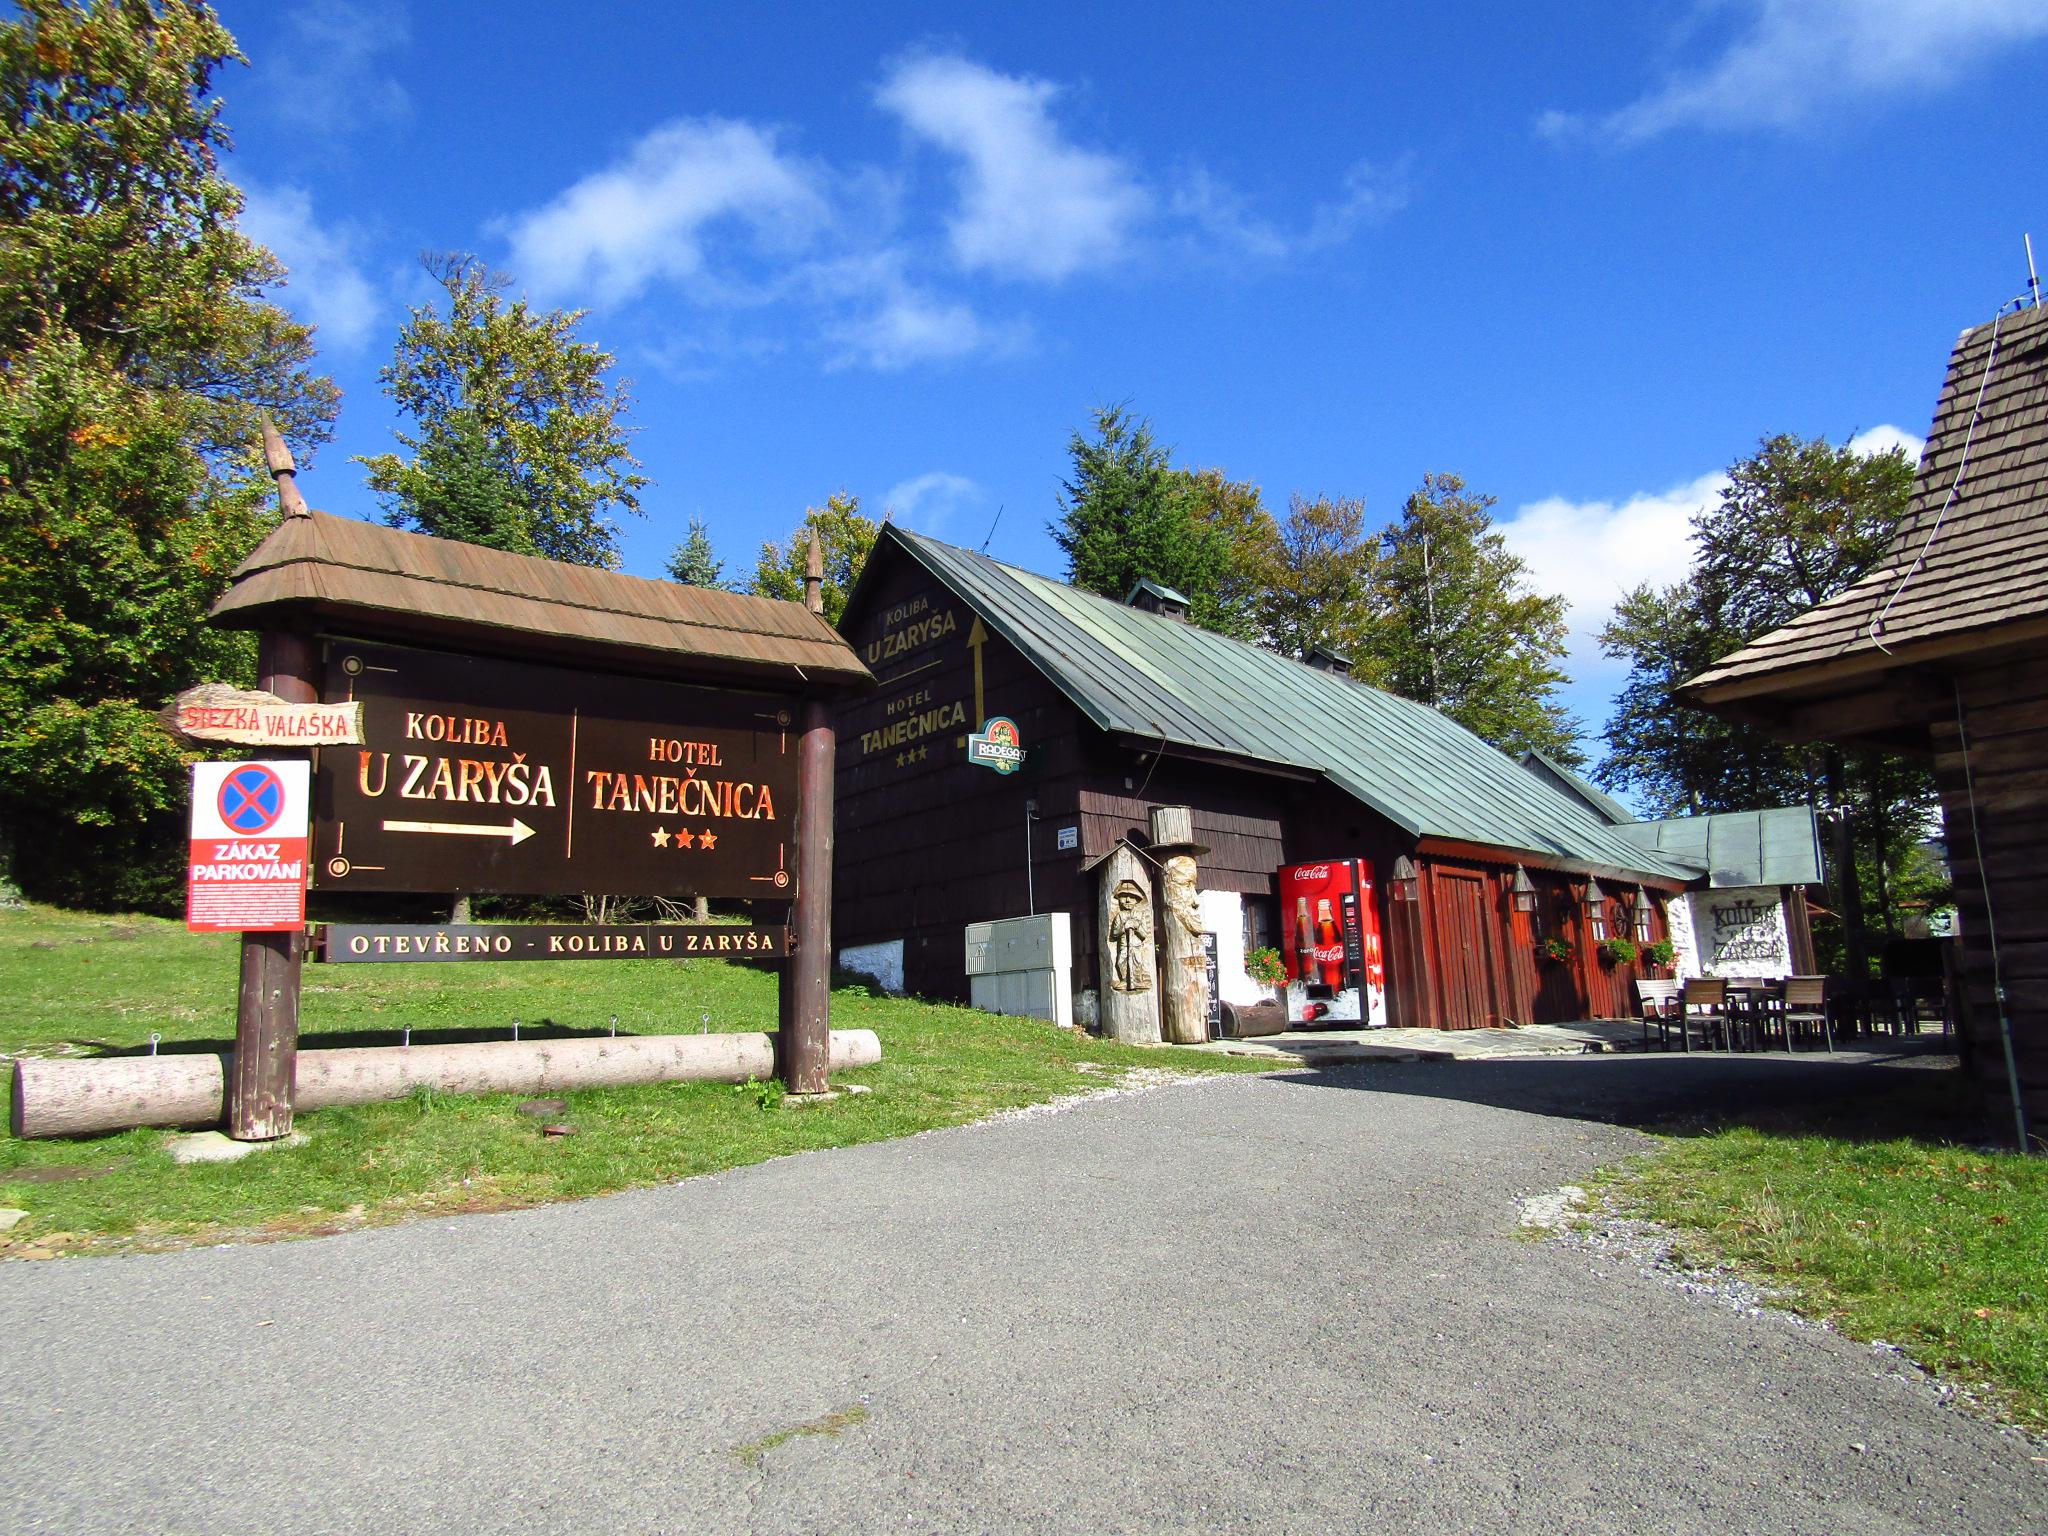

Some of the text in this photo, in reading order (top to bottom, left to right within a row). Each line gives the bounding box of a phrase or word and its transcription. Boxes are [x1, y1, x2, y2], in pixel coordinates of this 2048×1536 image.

[886, 597, 929, 626] KOLIBA
[868, 608, 957, 665] U ZARYŠA
[887, 690, 931, 715] HOTEL
[184, 707, 347, 737] STEZKA VALAŠKA
[407, 711, 509, 747] KOLIBA
[861, 701, 966, 755] TANEČNICA
[650, 737, 723, 767] HOTEL
[978, 743, 1028, 763] RADEGAST
[359, 750, 557, 807] U ZARYŠA
[587, 767, 776, 821] TANEČNICA
[214, 840, 281, 861] ZÁKAZ
[193, 859, 302, 881] PARKOVÁNÍ
[350, 931, 513, 954] OTEVŘENO
[550, 935, 646, 952] KOLIBA
[660, 935, 673, 950] U
[687, 931, 774, 951] ZARYŠA
